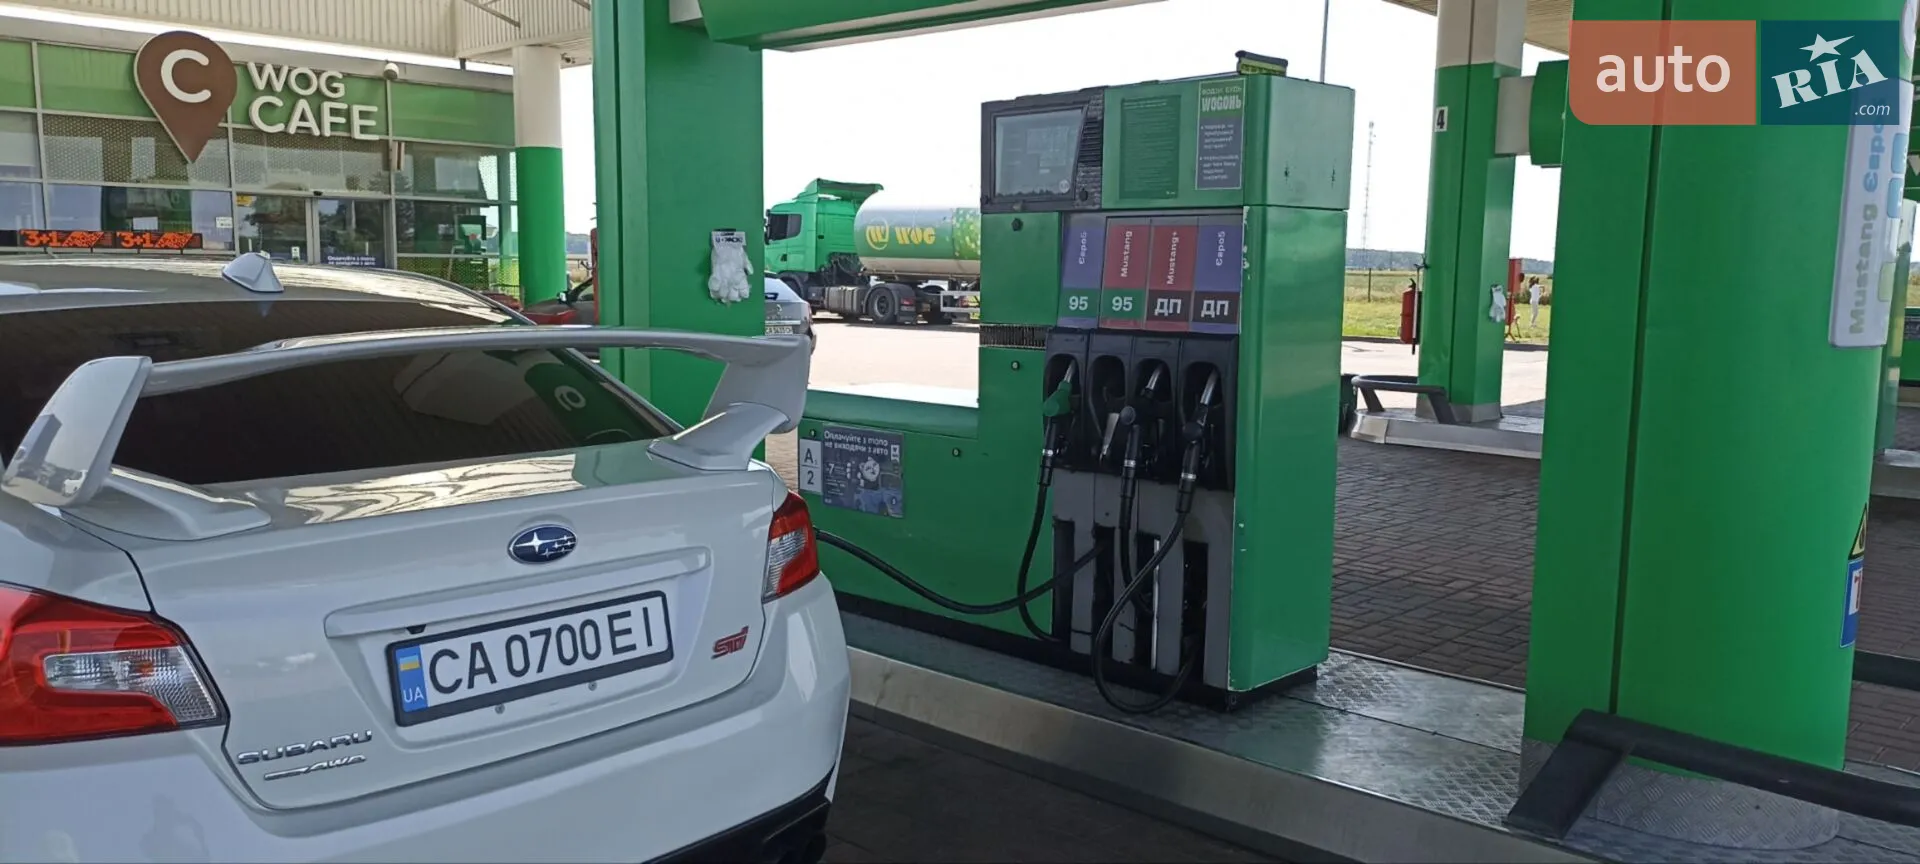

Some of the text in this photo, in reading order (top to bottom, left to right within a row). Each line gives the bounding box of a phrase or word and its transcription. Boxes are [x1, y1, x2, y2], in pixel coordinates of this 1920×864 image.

[248, 62, 346, 98] WOG
[250, 98, 379, 140] CAFE
[1436, 109, 1446, 129] 4
[895, 226, 937, 245] WOG
[1120, 230, 1133, 278] Mustang
[1166, 231, 1180, 285] Mustang+
[1849, 203, 1878, 335] Mustang
[1068, 295, 1089, 311] 95
[1111, 296, 1133, 312] 95
[1153, 298, 1182, 317] ДП
[1200, 300, 1229, 318] ДП
[807, 470, 814, 485] 2
[428, 641, 498, 694] CA
[505, 618, 602, 678] 0700
[403, 686, 424, 703] UA
[237, 730, 373, 765] SUBARU
